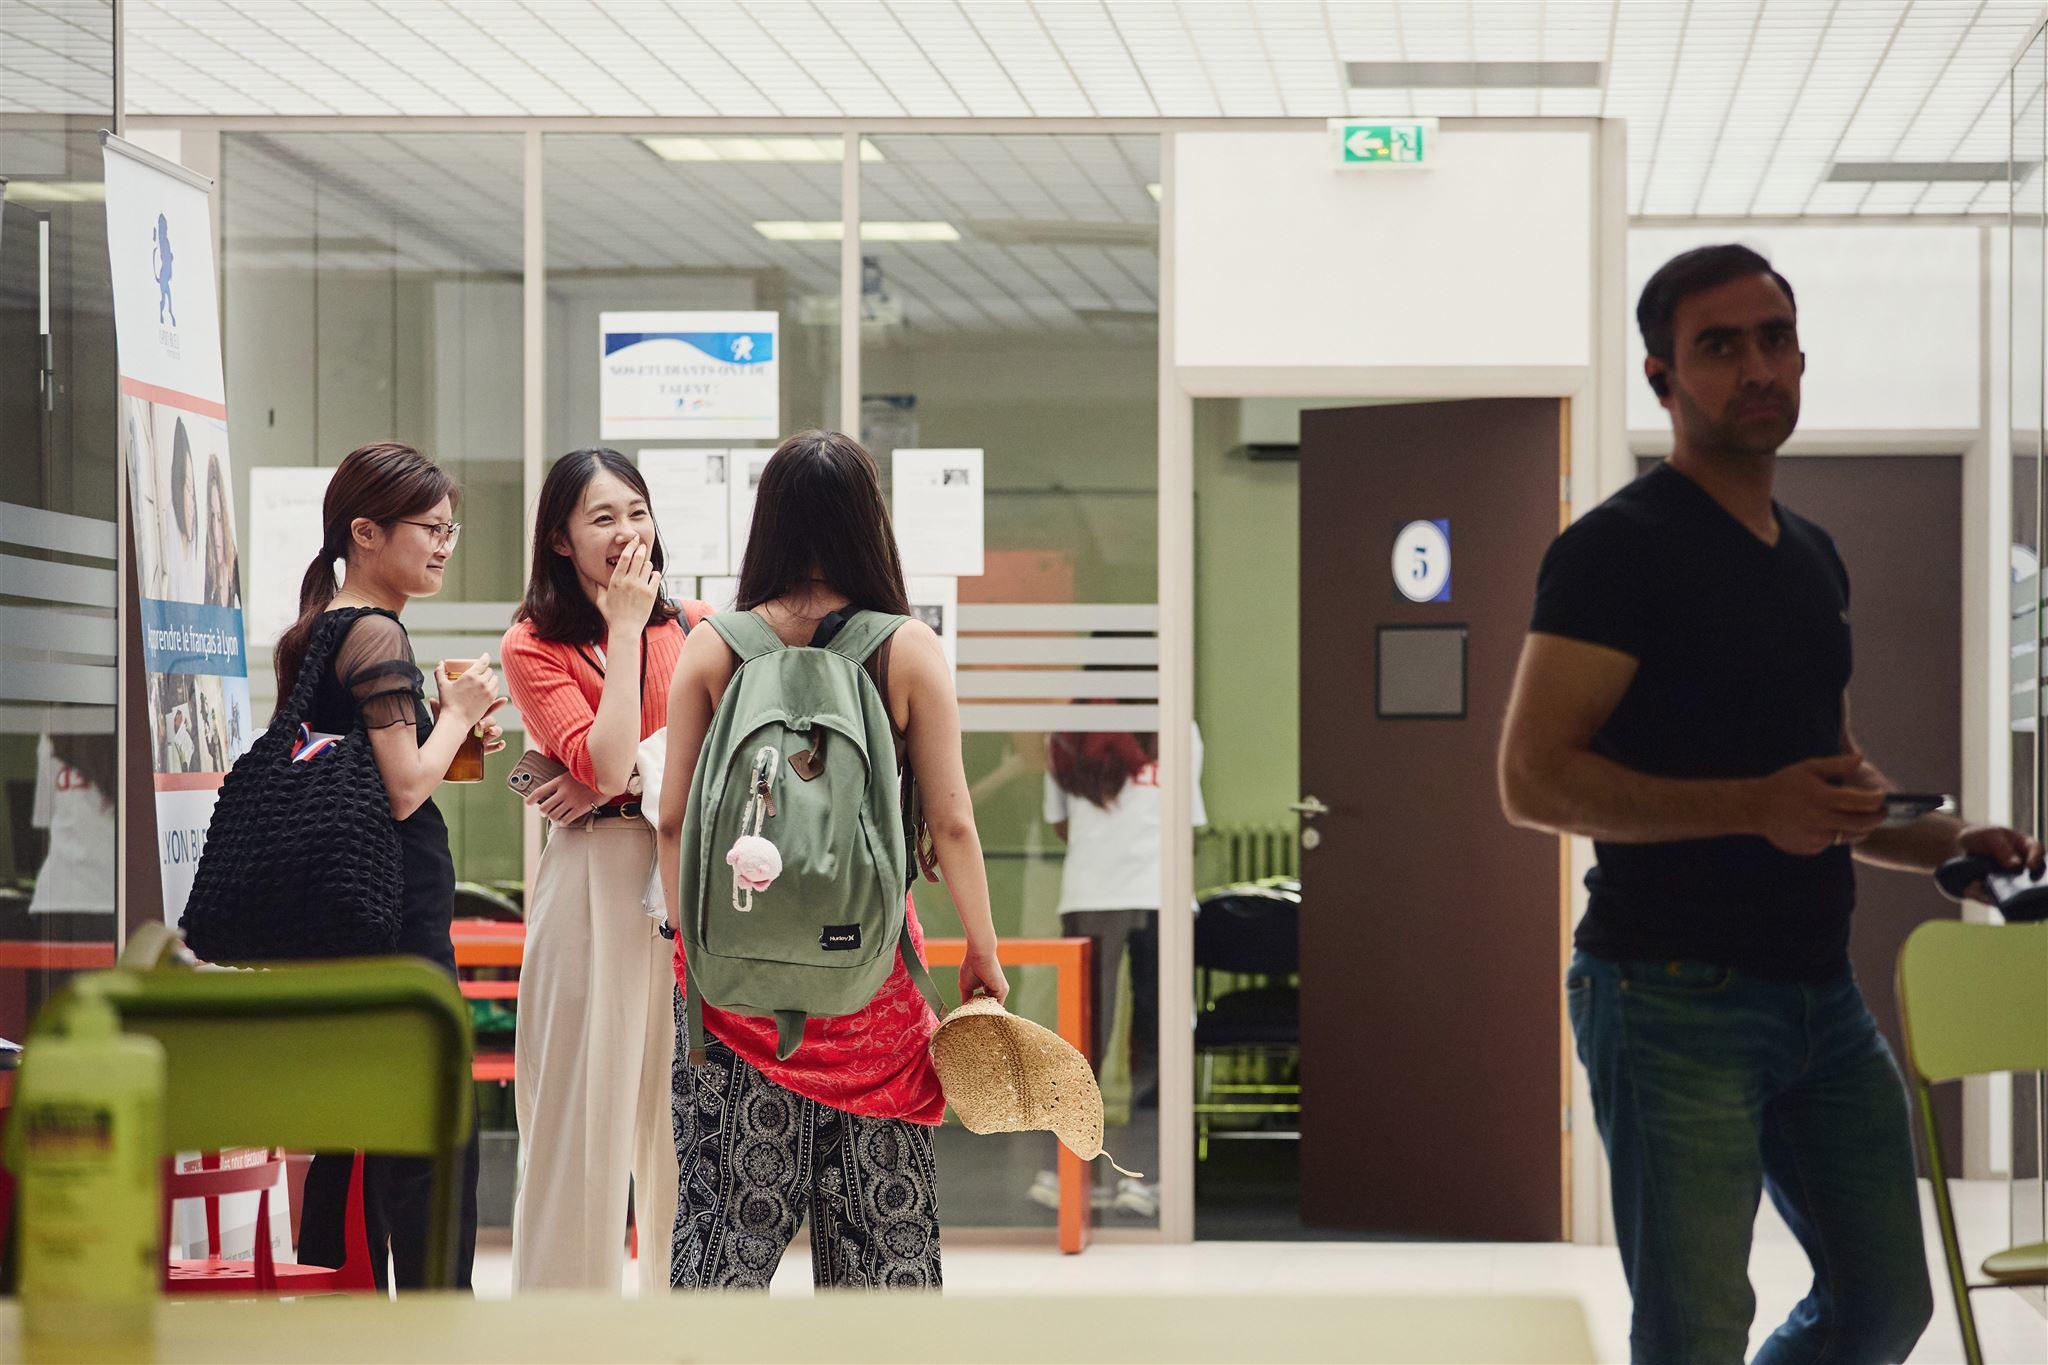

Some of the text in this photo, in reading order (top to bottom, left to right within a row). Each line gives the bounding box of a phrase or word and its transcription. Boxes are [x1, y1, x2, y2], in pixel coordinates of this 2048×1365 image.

[1411, 546, 1428, 580] 5
[182, 624, 189, 651] le
[190, 625, 216, 661] français
[216, 628, 221, 655] à
[222, 629, 239, 663] Lyon
